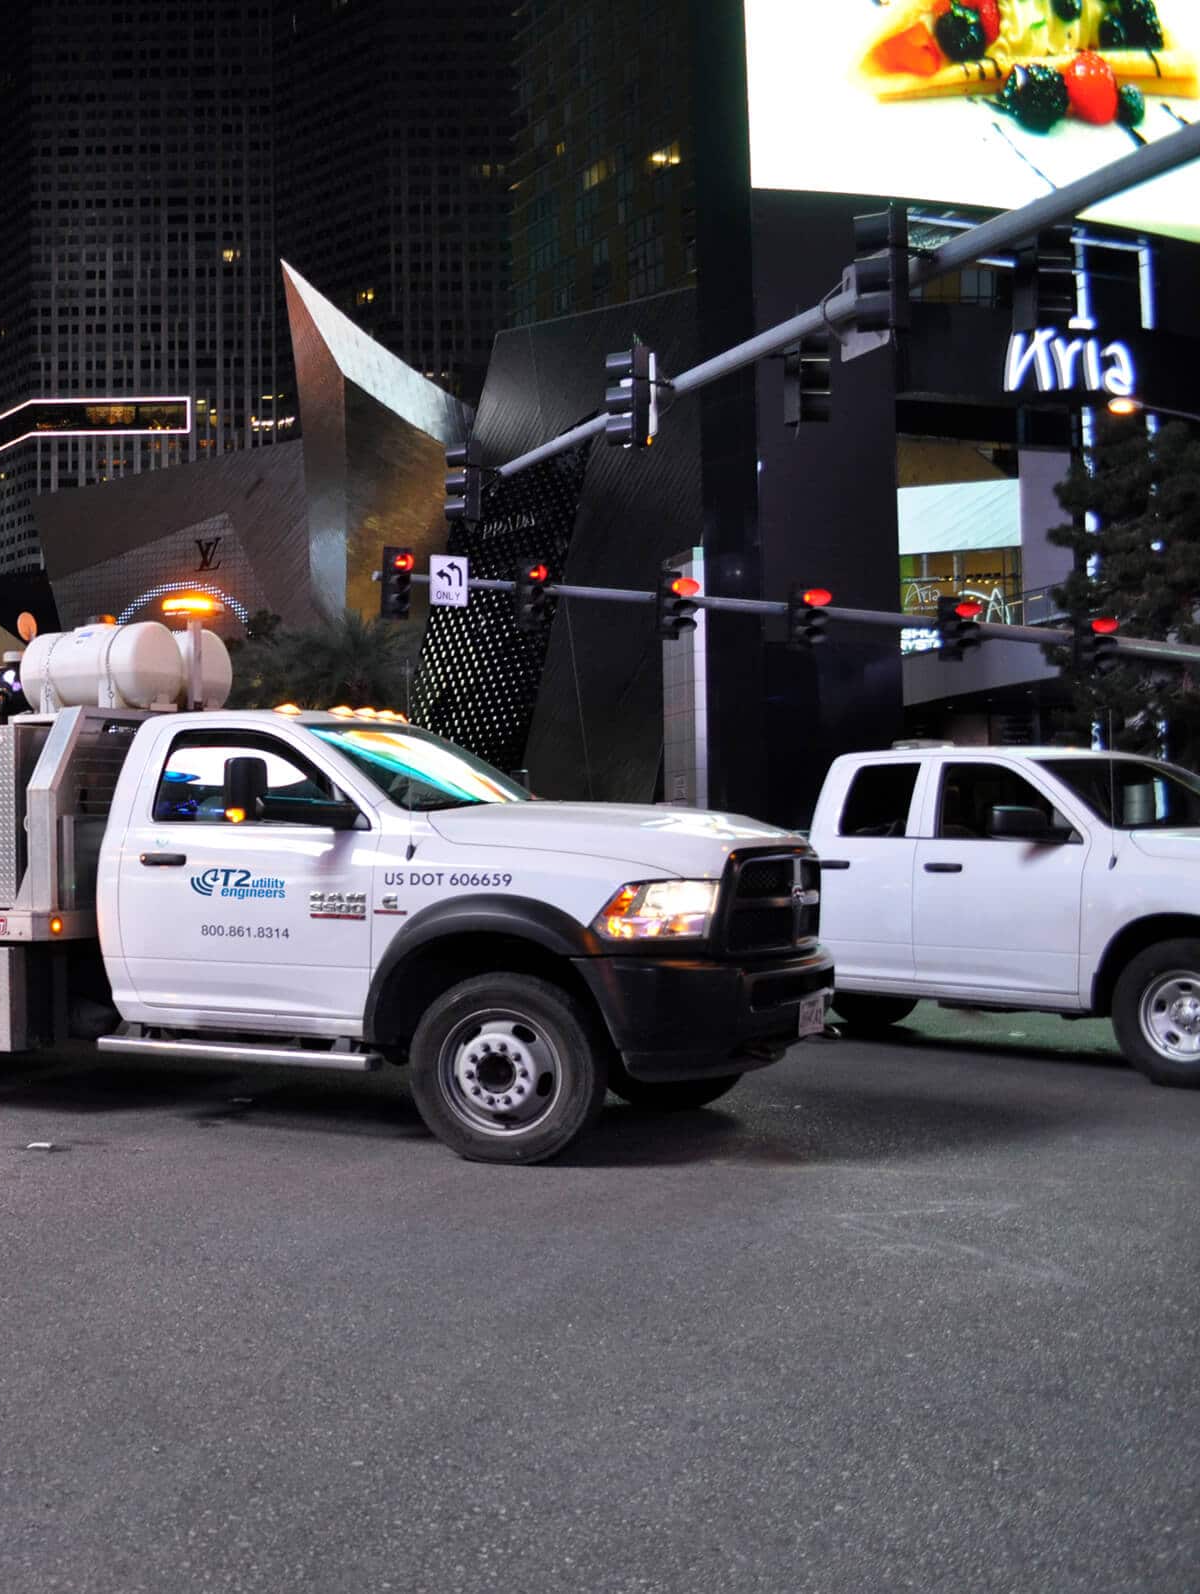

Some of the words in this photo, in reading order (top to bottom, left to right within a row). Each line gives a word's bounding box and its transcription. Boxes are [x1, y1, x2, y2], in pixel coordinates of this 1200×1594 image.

[435, 590, 460, 601] ONLY
[220, 868, 251, 887] T2
[252, 877, 285, 889] utility
[384, 872, 404, 886] US
[409, 872, 444, 886] DOT
[449, 873, 512, 887] 606659
[221, 887, 286, 900] engineers
[201, 924, 290, 939] 800.861.8314
